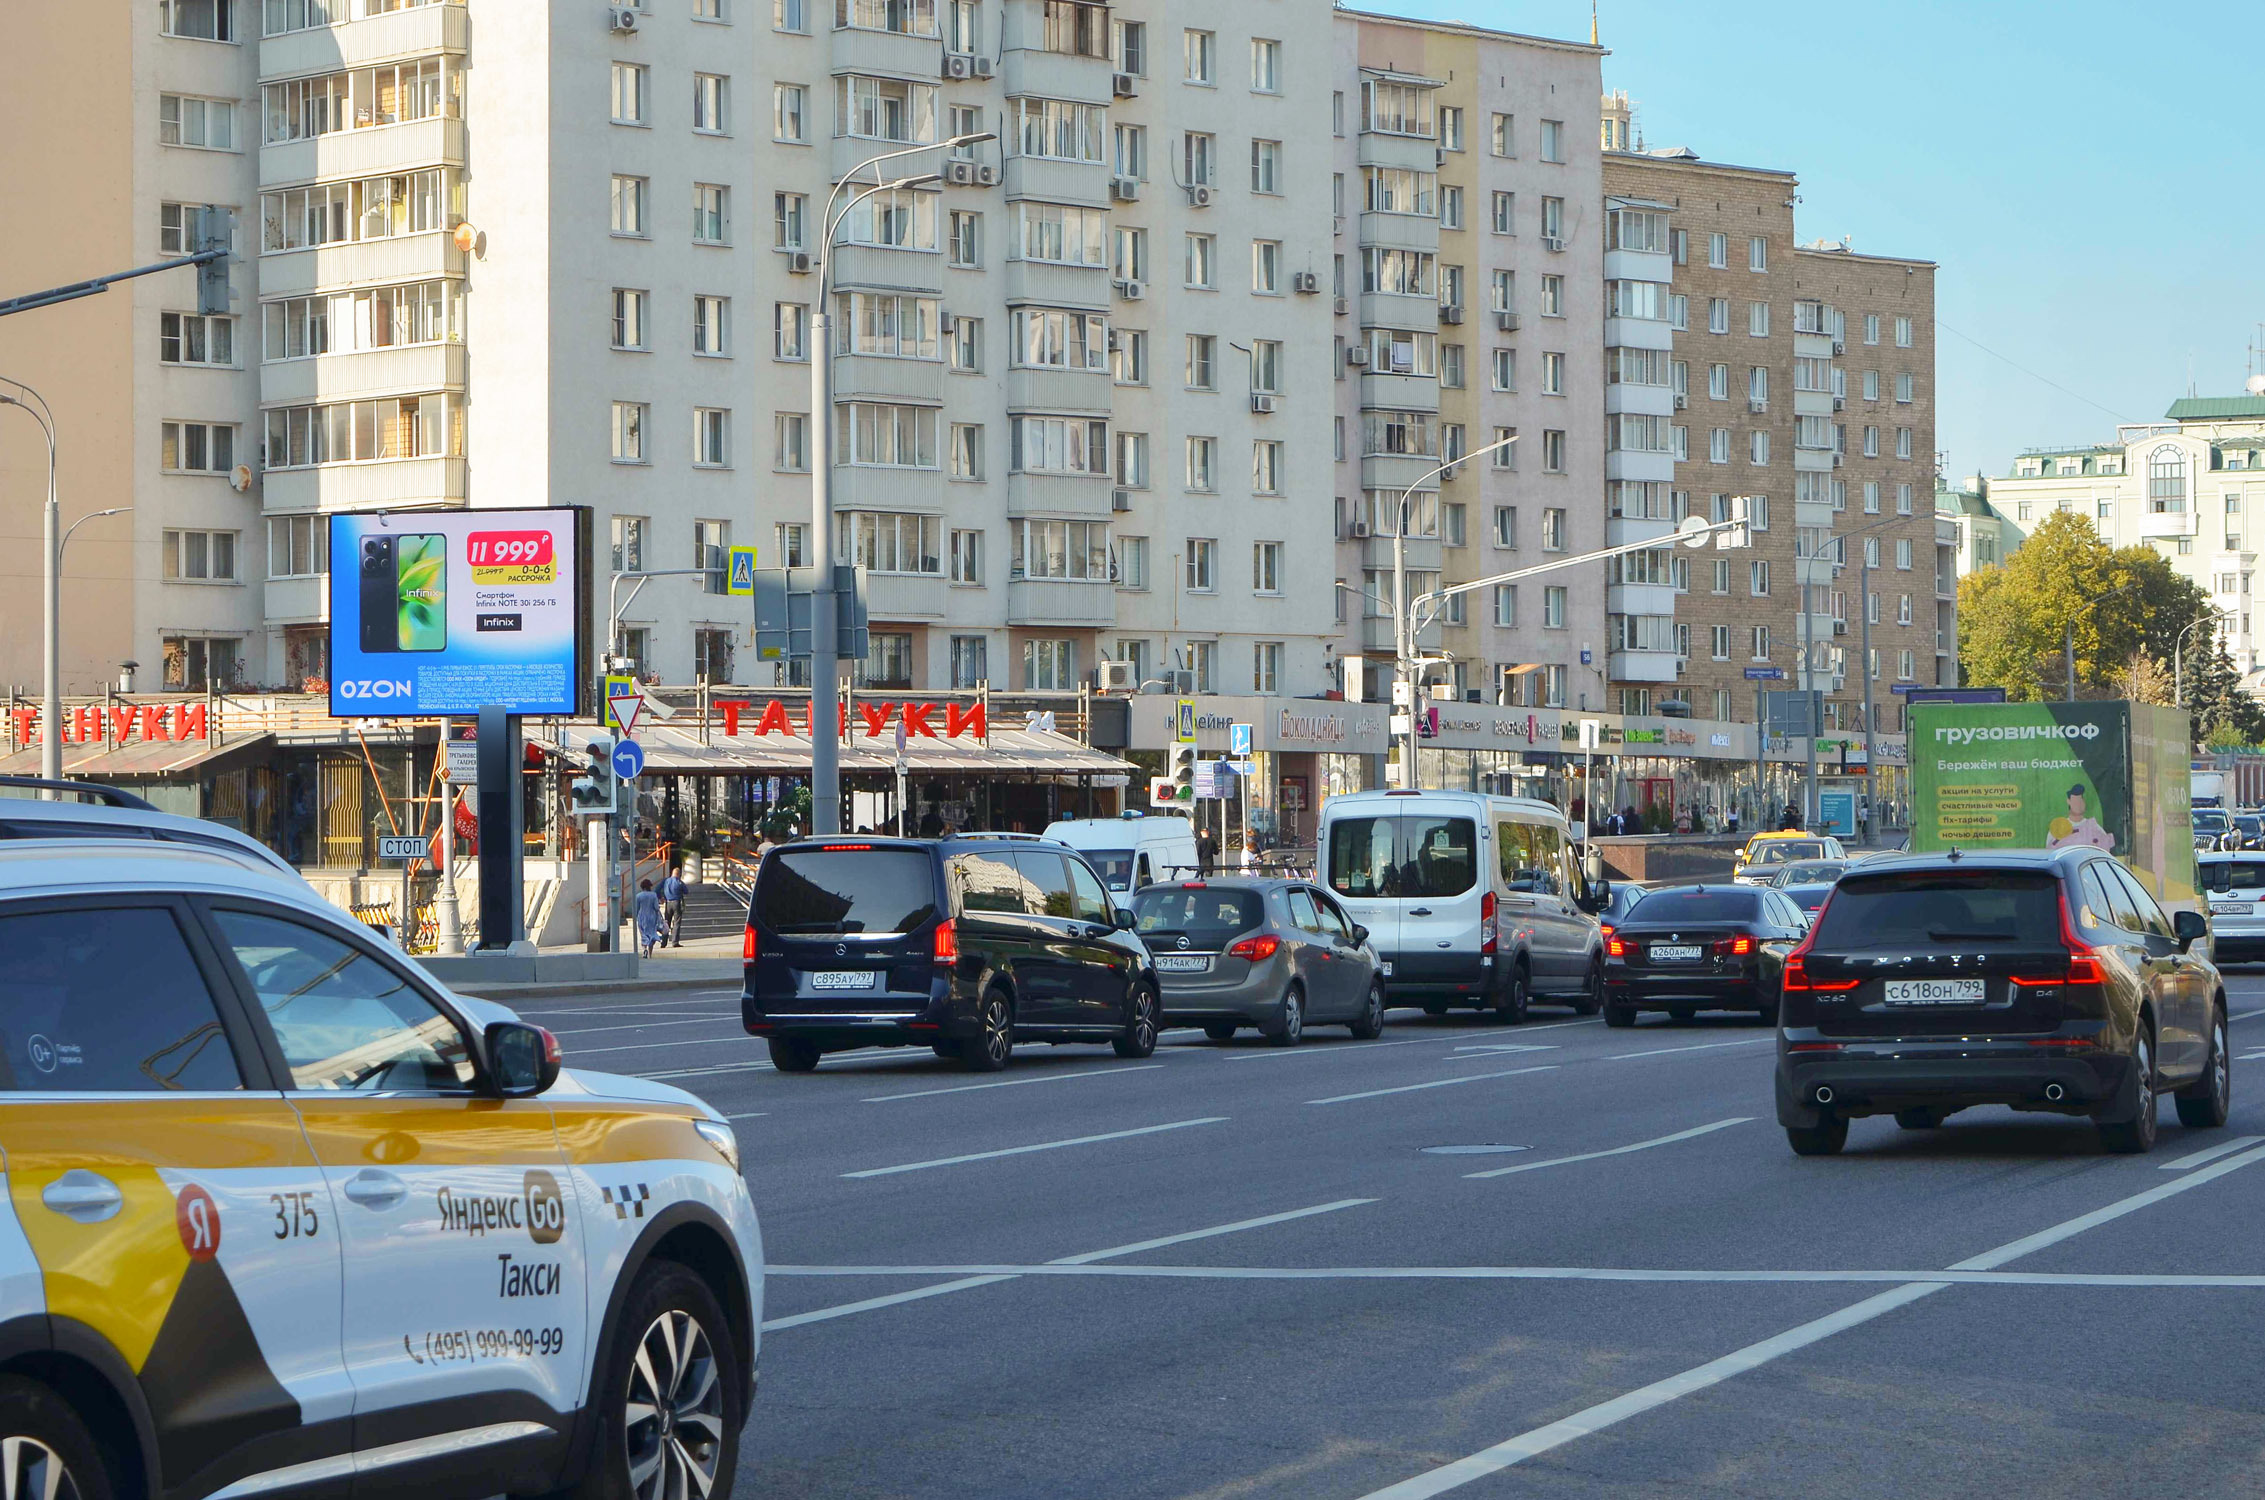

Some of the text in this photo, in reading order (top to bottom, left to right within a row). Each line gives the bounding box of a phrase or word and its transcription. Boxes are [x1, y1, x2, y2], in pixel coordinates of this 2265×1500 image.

[471, 542, 487, 562] 11
[494, 541, 538, 562] 999
[522, 565, 551, 574] 0-0-6
[406, 588, 439, 597] Infinix
[520, 599, 531, 607] 30i
[547, 598, 557, 606] ГБ
[483, 617, 515, 627] Infinix
[340, 680, 412, 699] OZON
[1026, 710, 1056, 732] 24
[1164, 712, 1234, 729] кейня
[1935, 723, 2100, 744] грузовичкоф
[1937, 758, 2084, 772] Бережём ваш бюджет
[1984, 787, 2015, 796] услуги
[1943, 816, 1993, 824] fix-тарифы
[1973, 830, 2013, 839] дешевле
[386, 840, 421, 854] СТОП
[1653, 947, 1685, 956] А260АН
[816, 972, 871, 984] С895АУ 797
[1890, 981, 1980, 999] С618ОН 799
[270, 1192, 318, 1240] 375
[438, 1185, 560, 1237] Яндекс Go
[188, 1198, 211, 1249] Я
[498, 1253, 560, 1298] Такси
[426, 1327, 563, 1366] (495) 999-99-99
